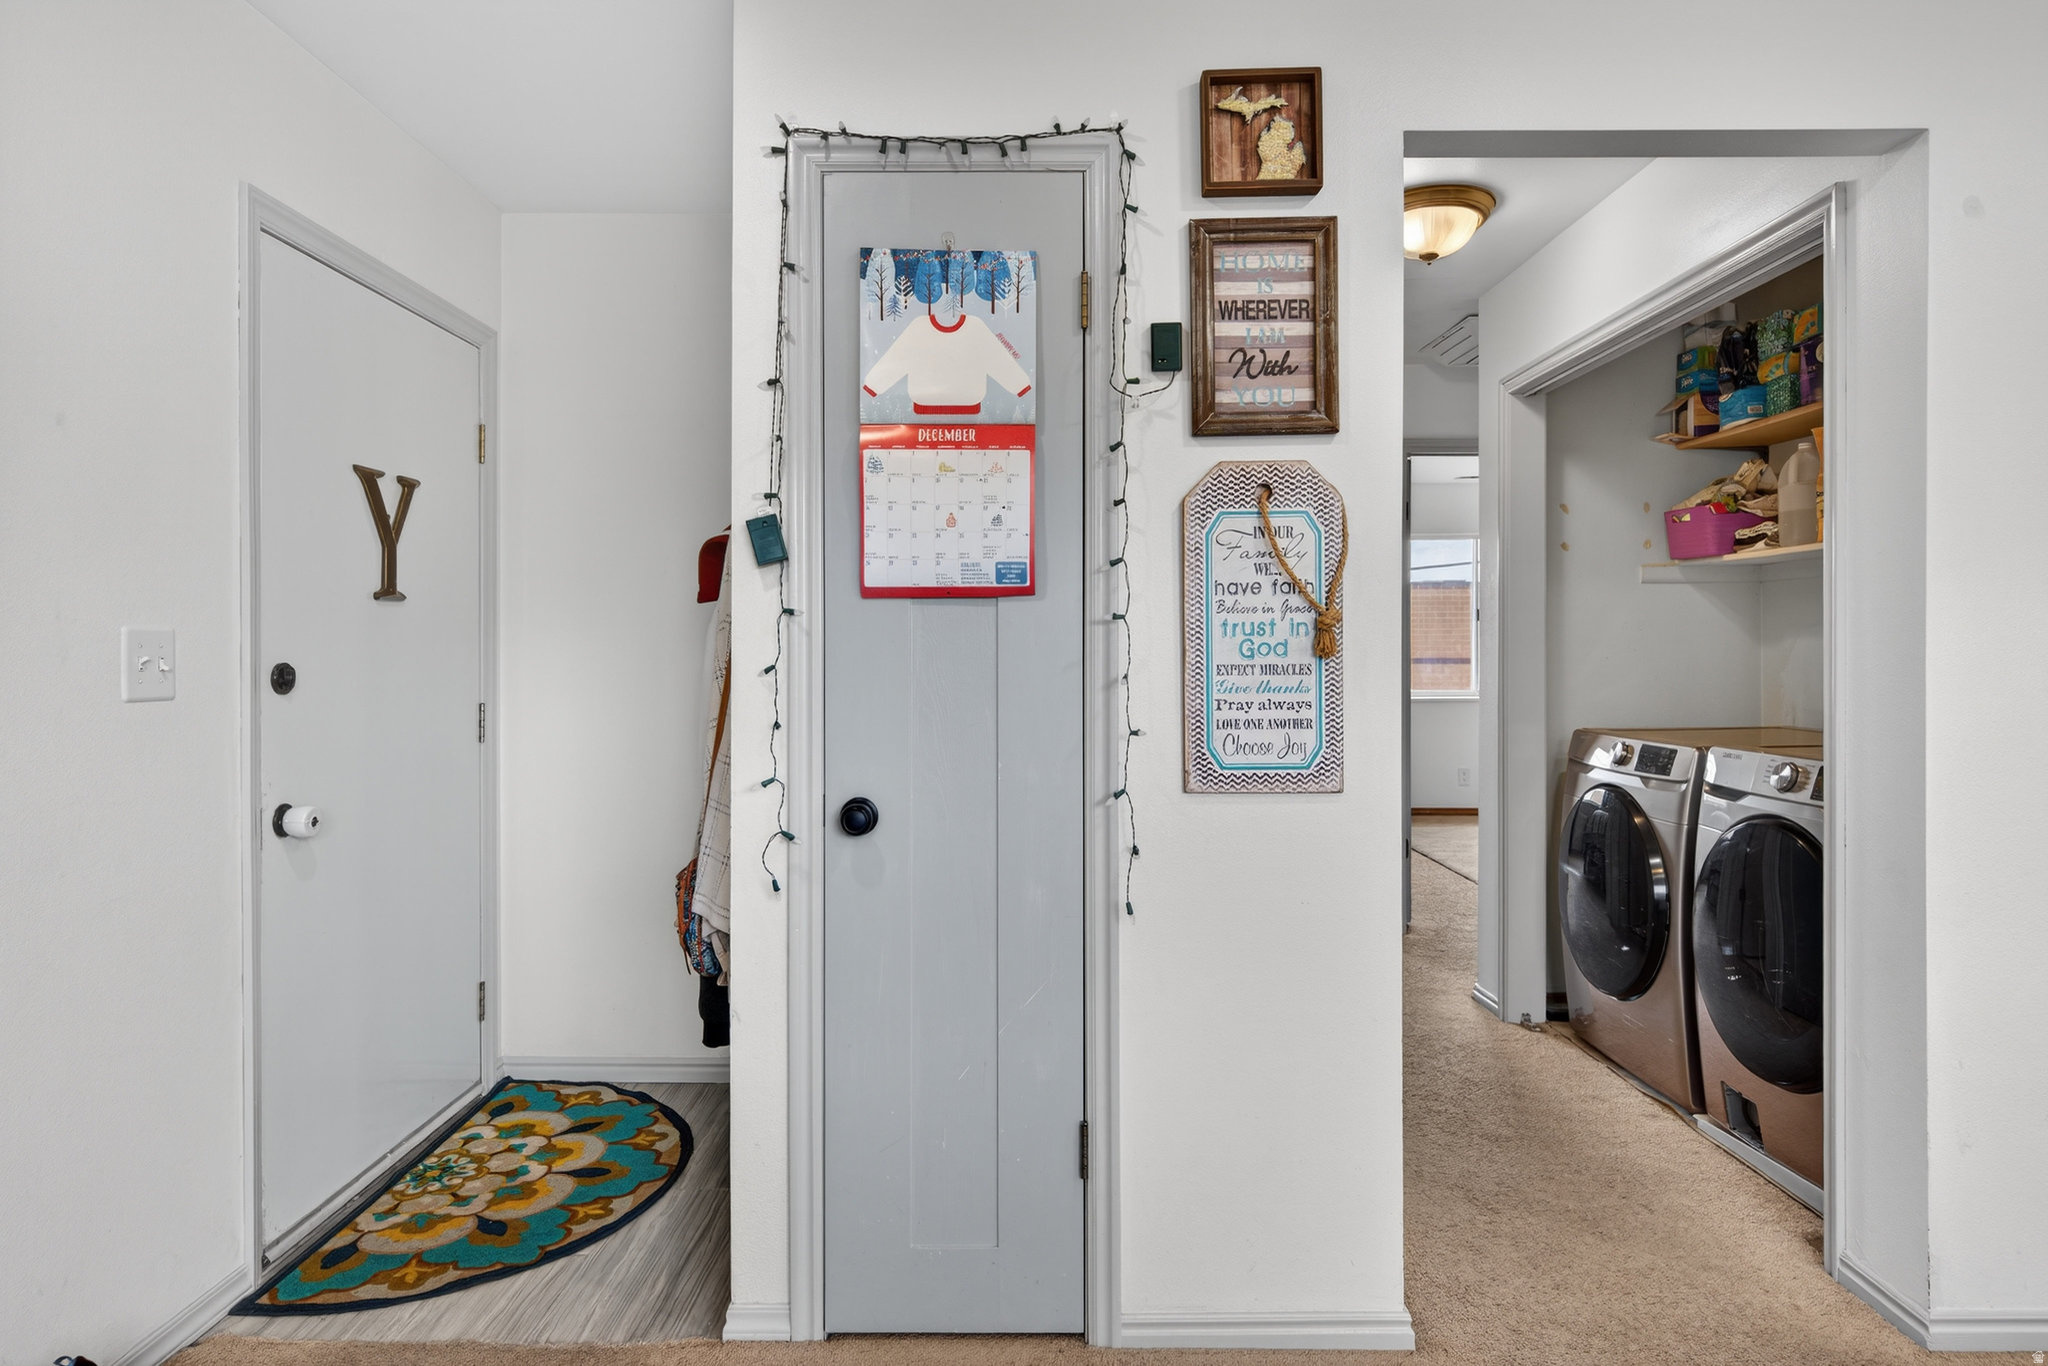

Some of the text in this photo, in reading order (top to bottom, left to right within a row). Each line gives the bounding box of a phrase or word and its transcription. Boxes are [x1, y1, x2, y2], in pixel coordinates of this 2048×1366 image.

[1219, 251, 1307, 272] HOME
[1257, 277, 1274, 294] IS
[1218, 299, 1310, 321] WHEREVER
[1245, 327, 1286, 345] I AM
[1228, 347, 1299, 380] With
[1231, 385, 1296, 408] YOU
[918, 428, 976, 442] DECEMBER
[352, 463, 421, 602] Y
[1253, 526, 1267, 539] IN
[1214, 579, 1262, 596] have
[1215, 599, 1316, 622] Believe in Grace
[1222, 618, 1310, 638] trust in
[1238, 638, 1289, 660] God
[1216, 663, 1313, 676] EXPECT MIRACLES
[1215, 679, 1312, 695] Give thanks
[1214, 699, 1312, 713] Pray always
[1216, 718, 1313, 730] LOVE ONE ANOTHER
[1222, 732, 1307, 761] Choose Joy
